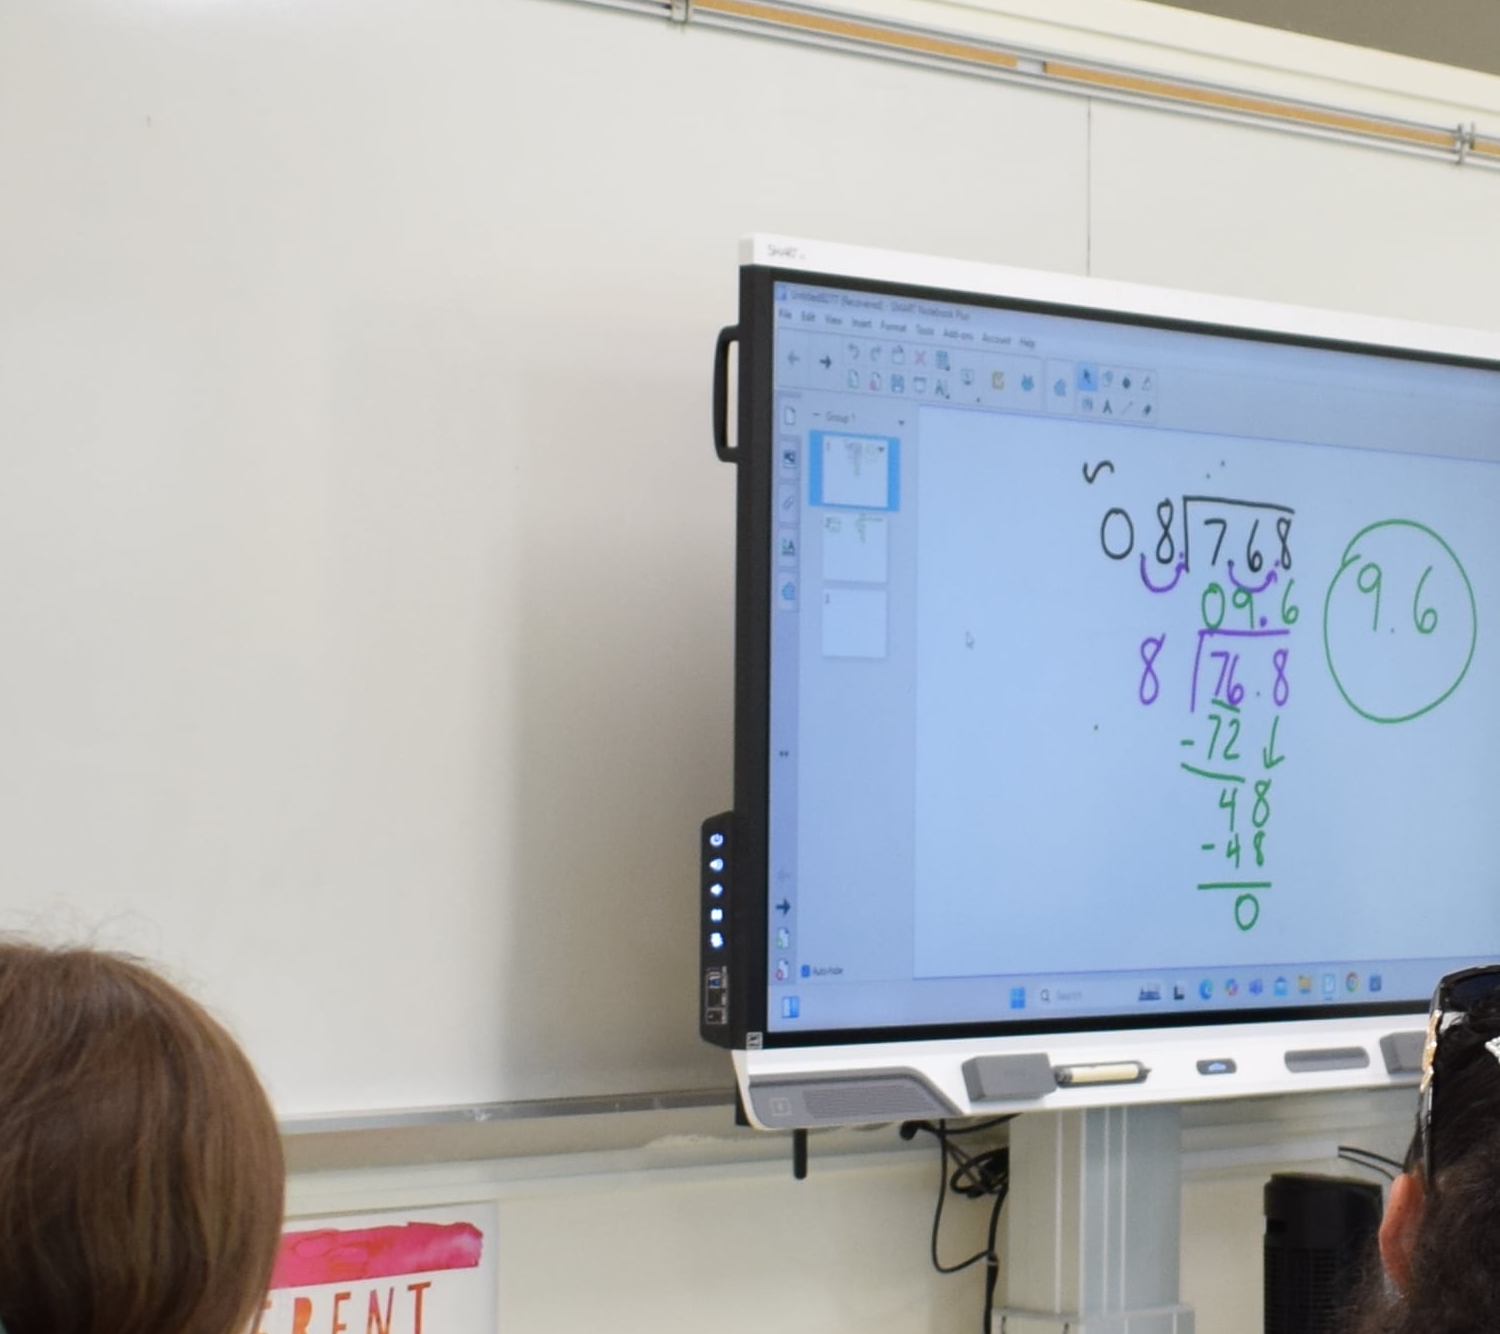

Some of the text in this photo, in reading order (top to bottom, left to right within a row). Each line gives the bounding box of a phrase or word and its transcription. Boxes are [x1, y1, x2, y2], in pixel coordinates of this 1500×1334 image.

[1357, 562, 1438, 634] 9.6
[1140, 633, 1165, 705] 8
[1219, 779, 1271, 832] 48
[1235, 893, 1259, 931] 0
